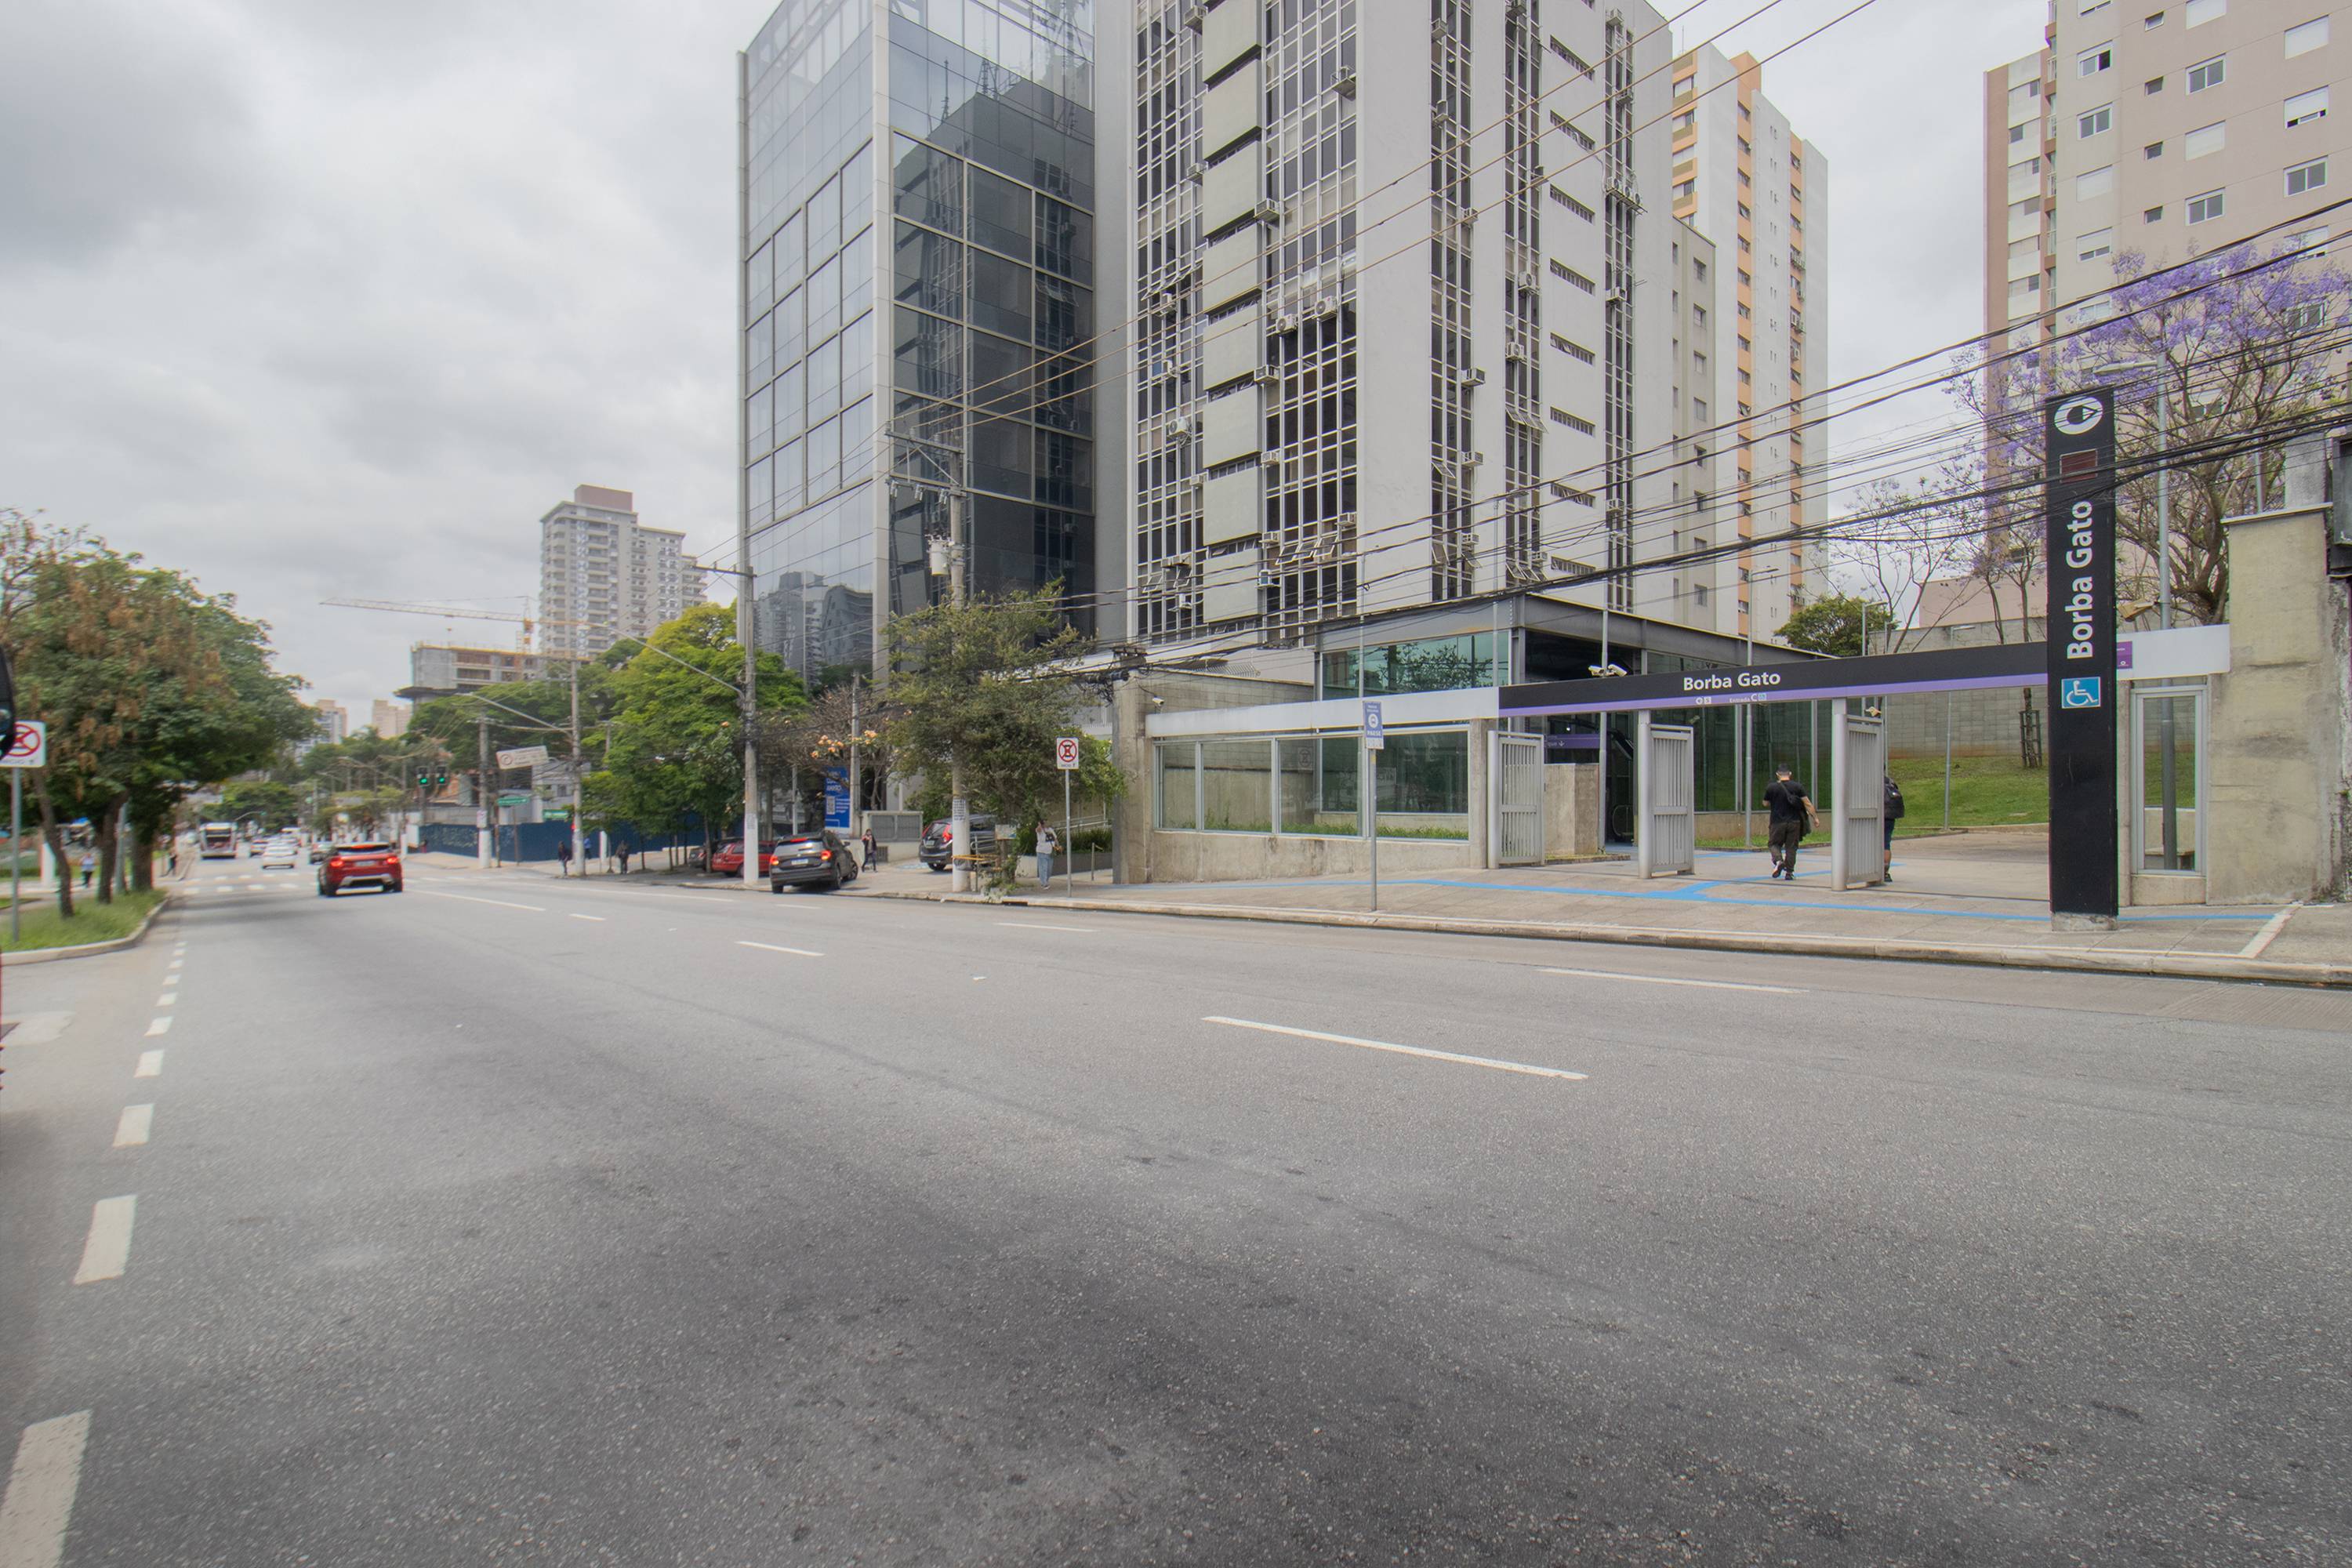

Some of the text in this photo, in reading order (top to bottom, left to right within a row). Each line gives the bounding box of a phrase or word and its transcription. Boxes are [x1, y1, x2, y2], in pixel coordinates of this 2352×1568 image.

[2065, 500, 2093, 659] Borba Gato
[1683, 672, 1781, 691] Borba Gato
